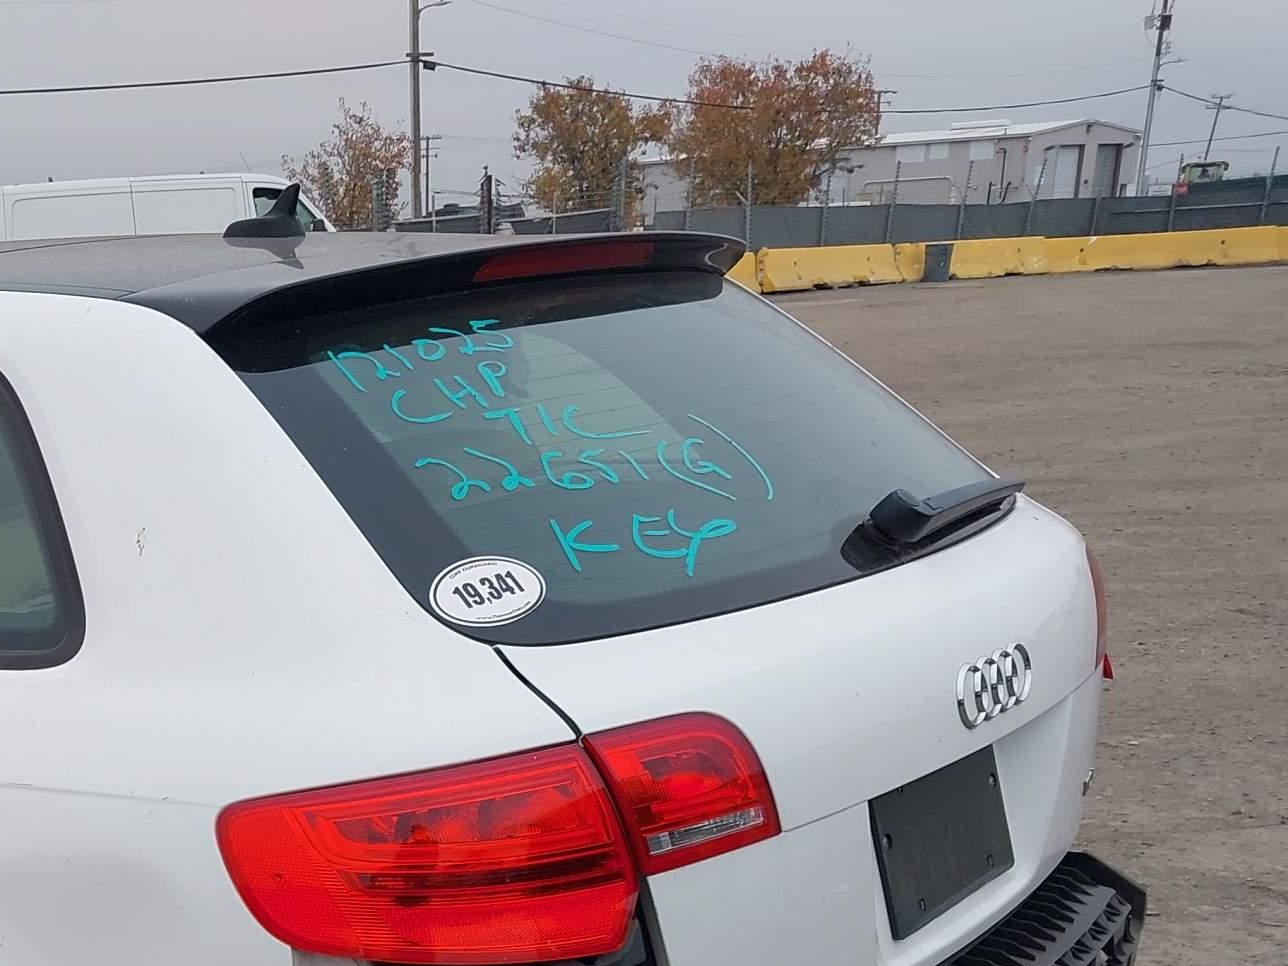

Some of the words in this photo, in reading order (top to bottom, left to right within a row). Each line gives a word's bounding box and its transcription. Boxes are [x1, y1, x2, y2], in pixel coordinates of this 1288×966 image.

[326, 319, 514, 393] 121025
[391, 360, 507, 424] CHP
[549, 508, 738, 577] KEY
[451, 570, 526, 609] 19,341
